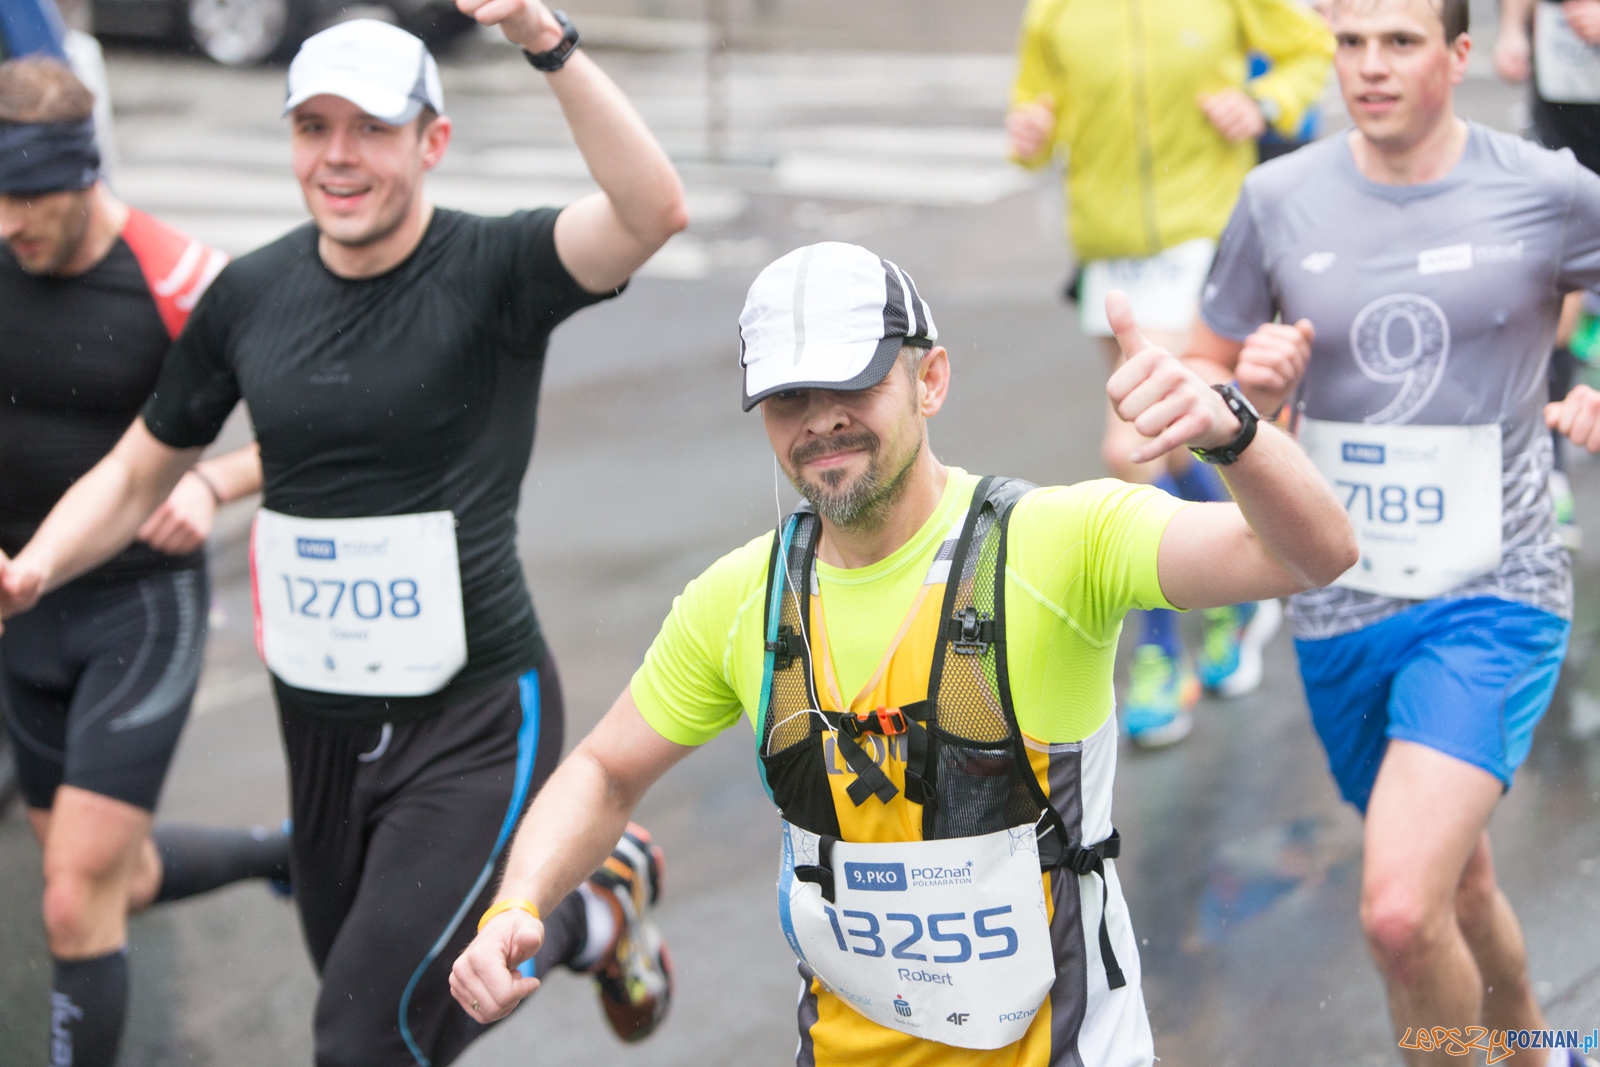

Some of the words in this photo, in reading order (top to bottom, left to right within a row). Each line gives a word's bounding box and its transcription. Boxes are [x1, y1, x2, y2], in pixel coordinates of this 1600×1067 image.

[1334, 479, 1446, 525] 7189
[281, 574, 421, 620] 12708
[853, 870, 898, 884] 9.PKO
[823, 904, 1019, 963] 13255
[898, 968, 953, 986] Robert
